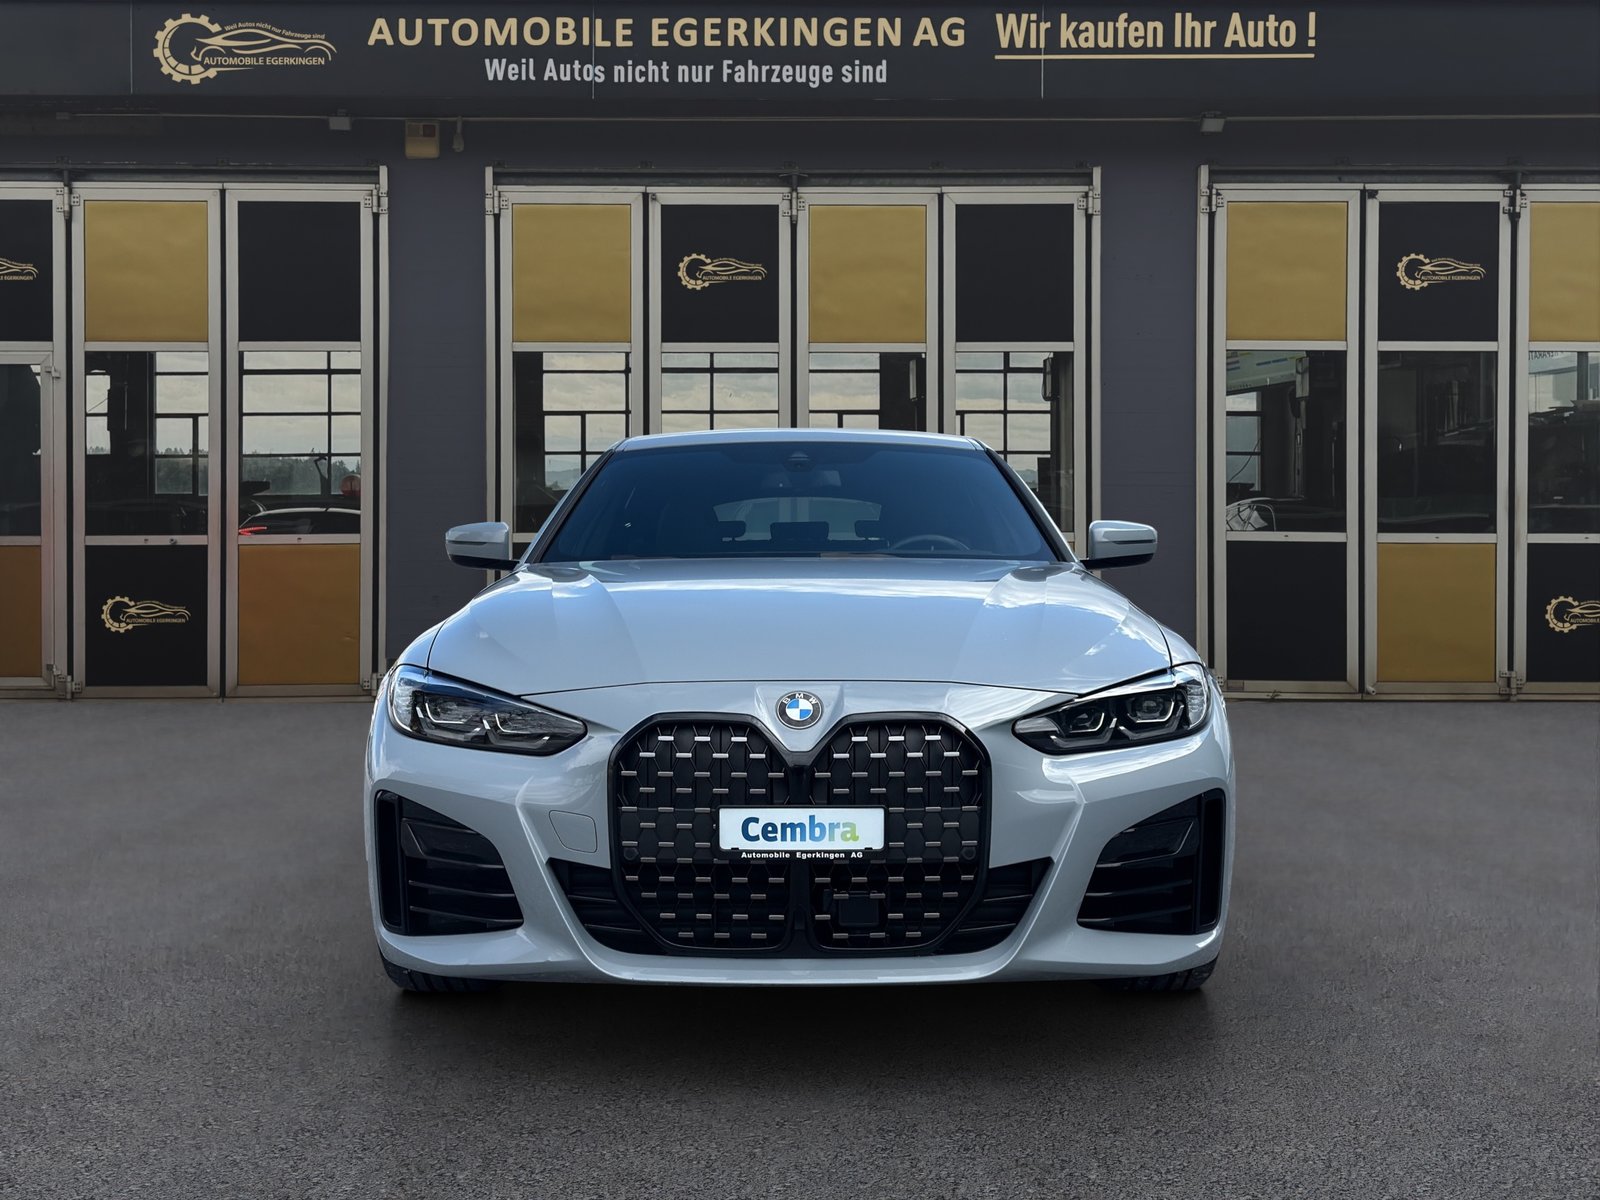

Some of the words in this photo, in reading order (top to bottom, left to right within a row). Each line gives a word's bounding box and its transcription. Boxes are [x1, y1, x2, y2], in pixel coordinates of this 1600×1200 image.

[224, 23, 238, 31] Weil
[256, 22, 271, 30] nicht
[281, 29, 311, 40] Fahrzeuge
[367, 17, 634, 47] AUTOMOBILE
[651, 17, 902, 47] EGERKINGEN
[912, 17, 966, 47] AG
[995, 12, 1050, 49] Wir
[1059, 12, 1164, 48] kaufen
[1174, 12, 1216, 48] Ihr
[1223, 12, 1297, 47] Auto
[1307, 11, 1316, 47] !
[203, 57, 264, 66] AUTOMOBILE
[266, 57, 325, 66] EGERKINGEN
[484, 58, 535, 81] Weil
[543, 58, 605, 83] Autos
[613, 60, 670, 83] nicht
[677, 64, 714, 83] nur
[722, 59, 834, 88] Fahrzeuge
[841, 59, 887, 83] sind
[741, 815, 859, 842] Cembra
[796, 852, 845, 860] Egerkingen
